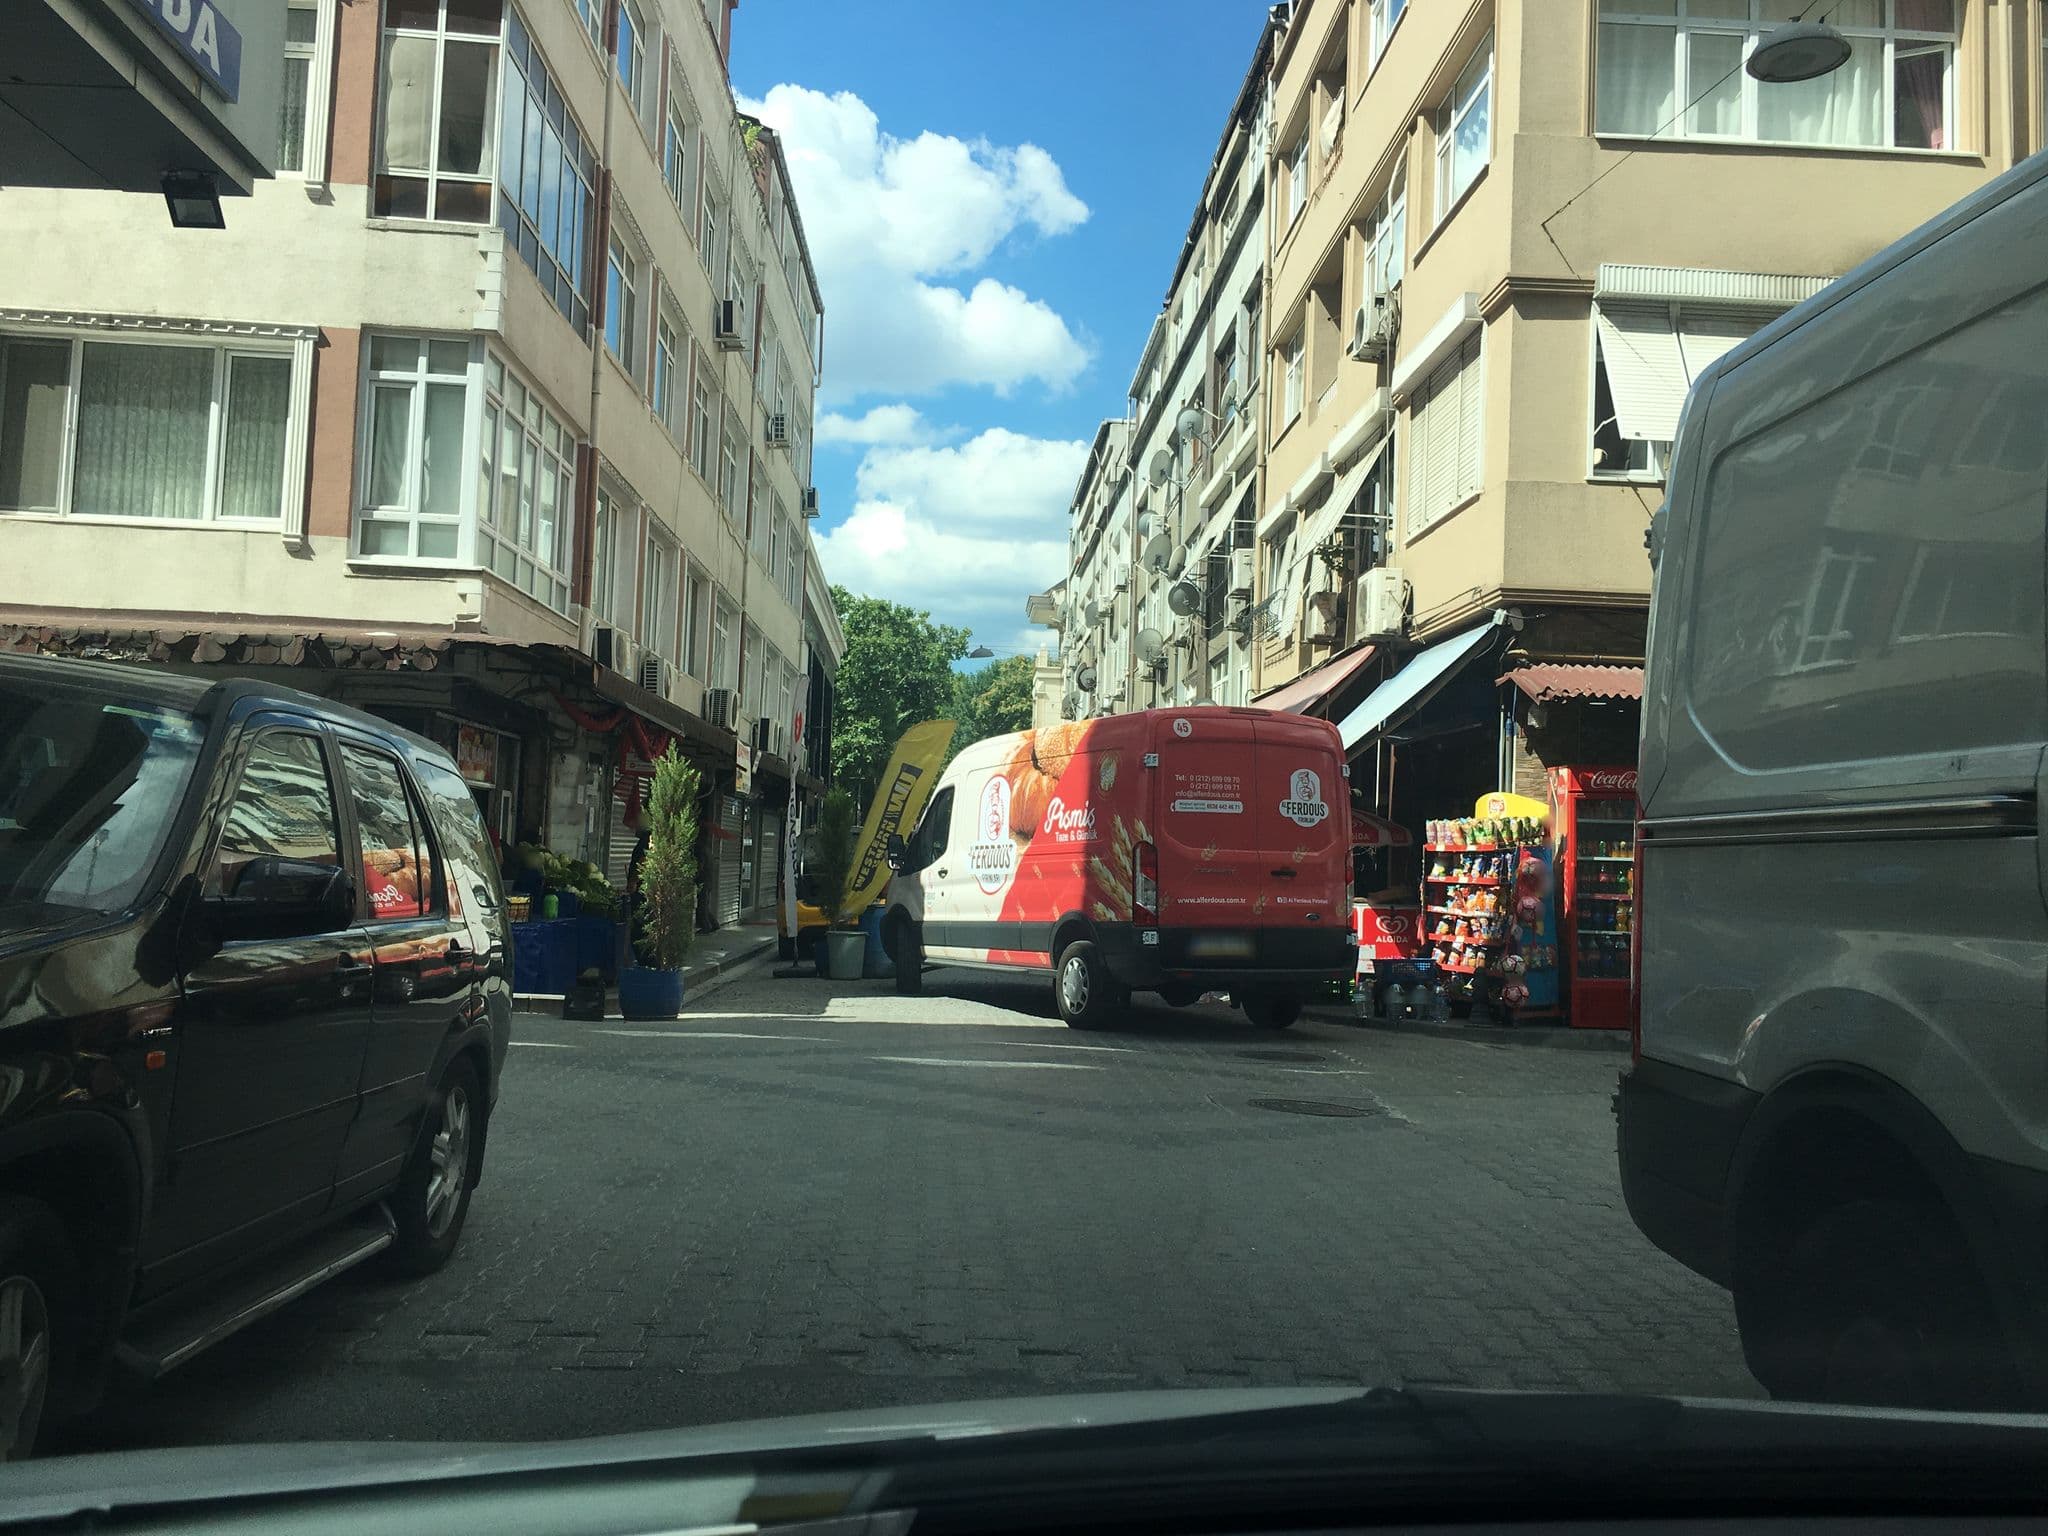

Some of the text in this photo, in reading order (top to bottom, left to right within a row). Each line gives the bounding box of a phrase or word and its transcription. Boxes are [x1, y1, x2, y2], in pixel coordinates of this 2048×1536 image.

[1176, 722, 1189, 733] 45
[1196, 775, 1211, 783] (212)
[1591, 770, 1637, 789] Coca-Col
[1286, 802, 1325, 816] FERDOUS
[855, 819, 889, 890] WESTERN
[970, 843, 1014, 869] FERDOUS
[1177, 896, 1247, 905] www.alferdous.com.tr
[1375, 935, 1409, 944] ALGIDA
